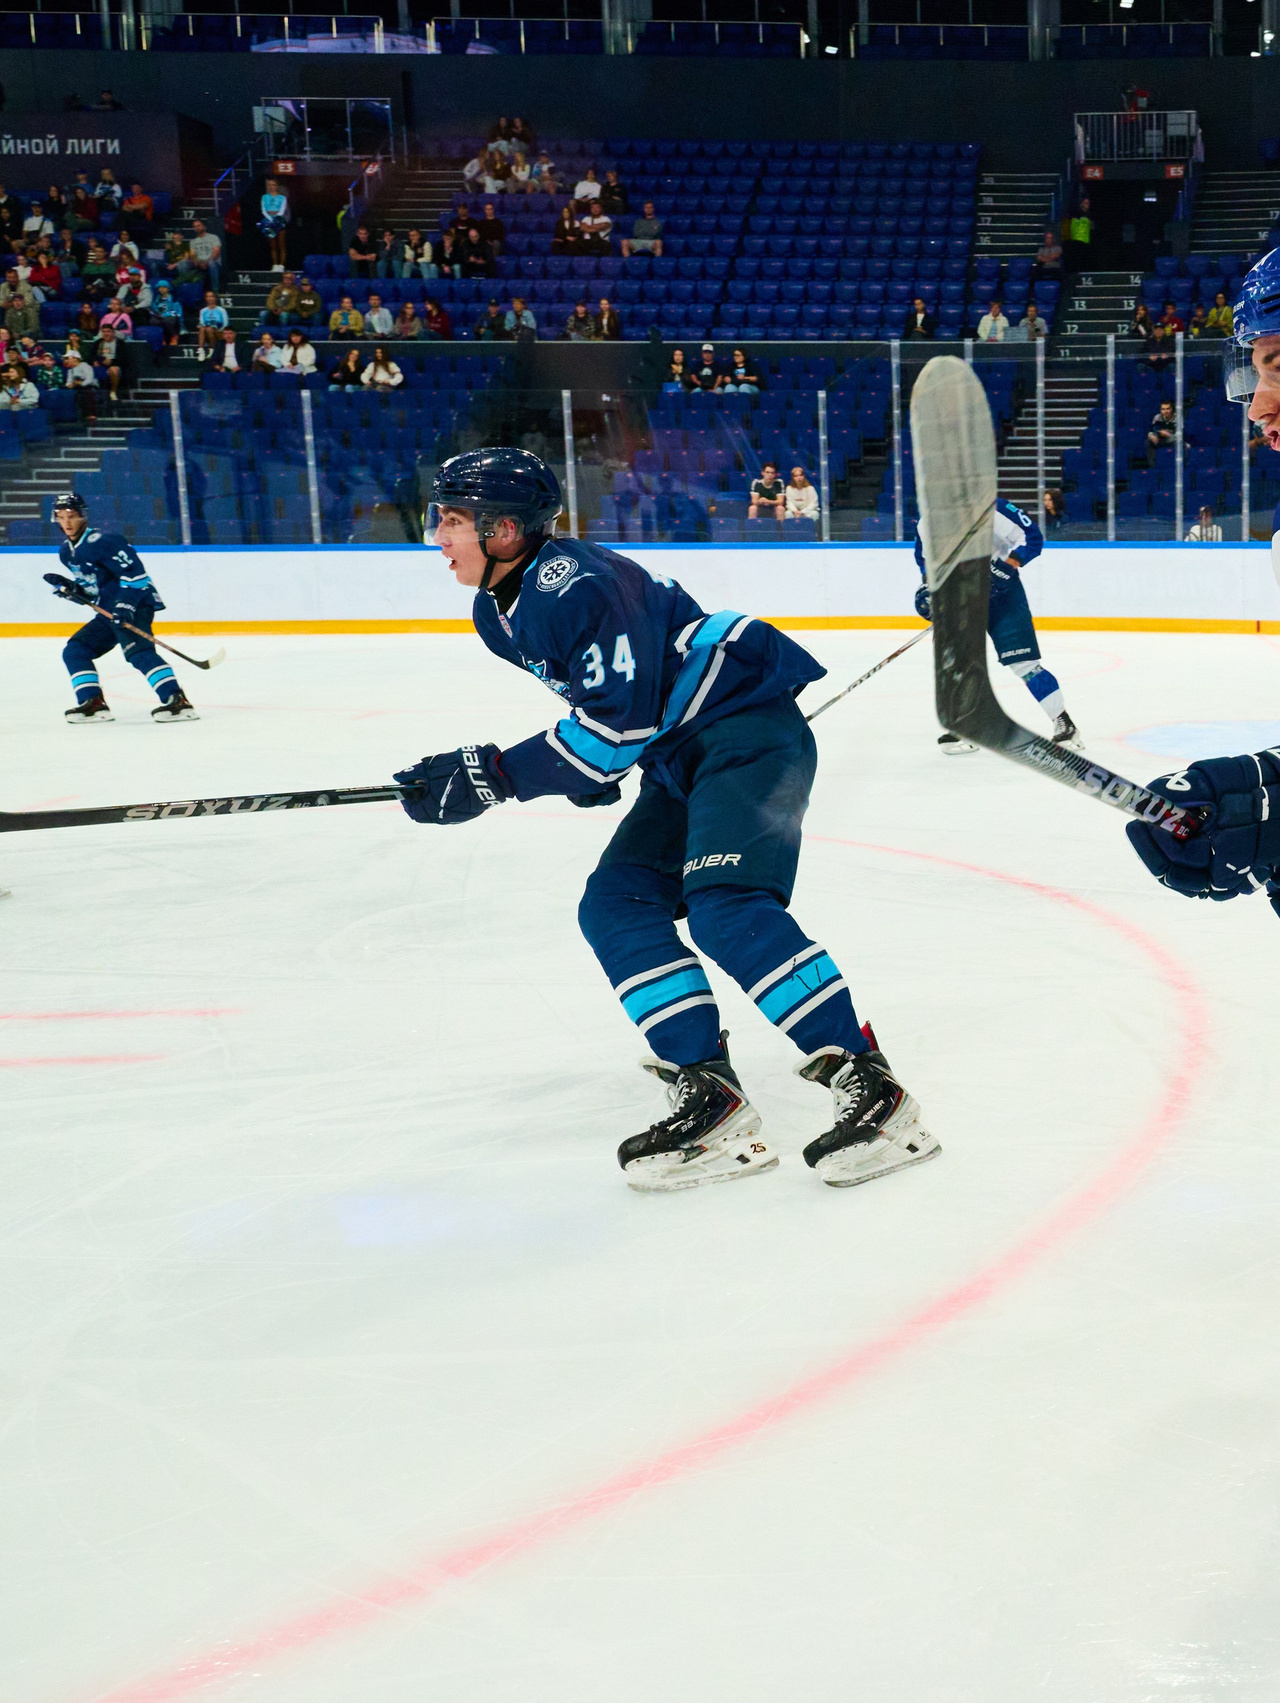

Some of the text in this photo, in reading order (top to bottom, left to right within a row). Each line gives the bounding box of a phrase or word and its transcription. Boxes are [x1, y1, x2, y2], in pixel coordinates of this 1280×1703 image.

[0, 134, 120, 154] ЙНОЙ ЛИГИ
[183, 211, 195, 219] 17
[238, 274, 251, 284] 14
[1081, 277, 1093, 286] 14
[1130, 275, 1141, 284] 14
[220, 297, 233, 308] 13
[1074, 301, 1087, 310] 13
[1123, 300, 1135, 310] 13
[1066, 324, 1079, 334] 12
[1117, 324, 1130, 334] 12
[582, 633, 636, 689] 34
[1076, 767, 1187, 832] SOYUZ
[123, 795, 293, 822] SOYUZ
[683, 853, 742, 879] AUER
[750, 1142, 767, 1154] 25
